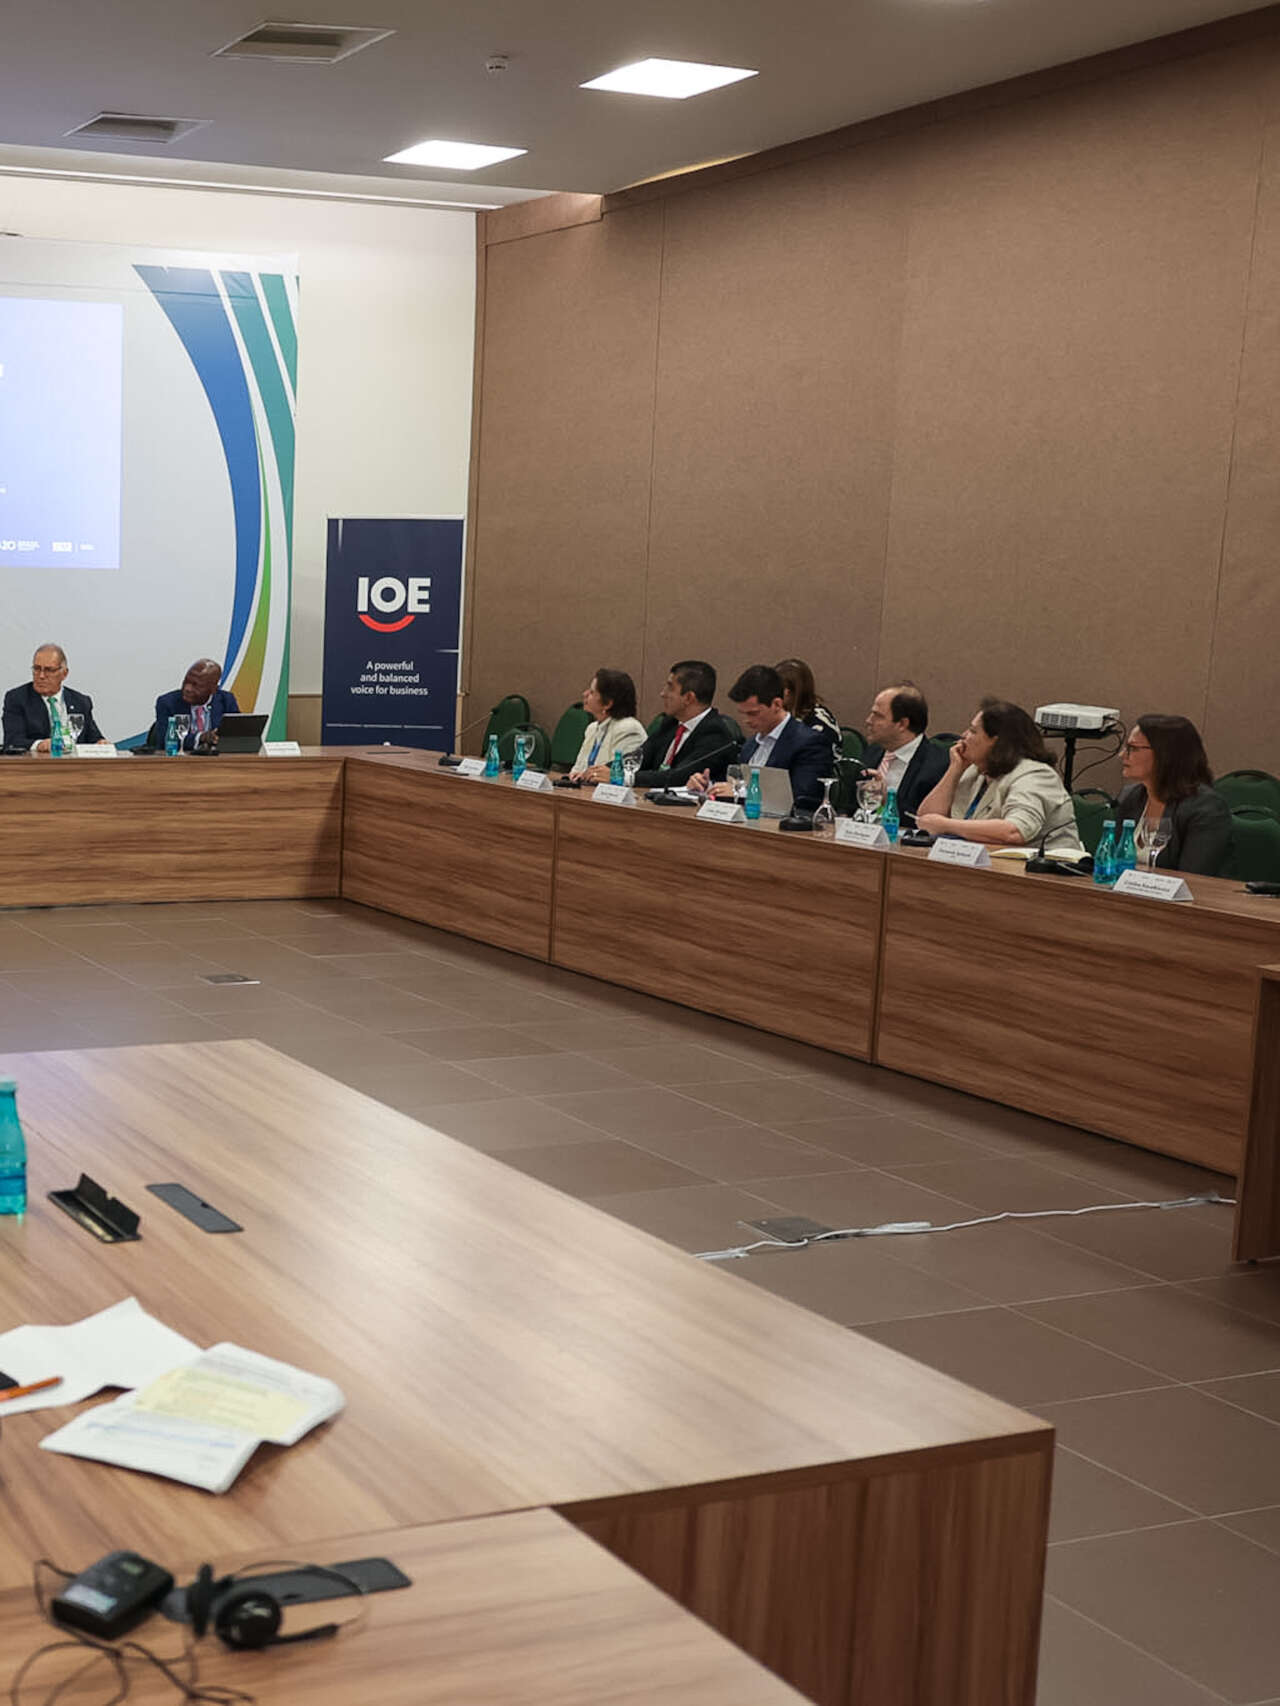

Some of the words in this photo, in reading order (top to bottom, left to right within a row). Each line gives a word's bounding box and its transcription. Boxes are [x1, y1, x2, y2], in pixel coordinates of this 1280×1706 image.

[357, 577, 431, 613] IOE
[366, 661, 374, 670] A
[374, 661, 414, 672] powerful
[360, 673, 377, 682] and
[379, 673, 420, 683] balanced
[350, 685, 375, 695] voice
[375, 685, 388, 695] for
[389, 686, 428, 696] business
